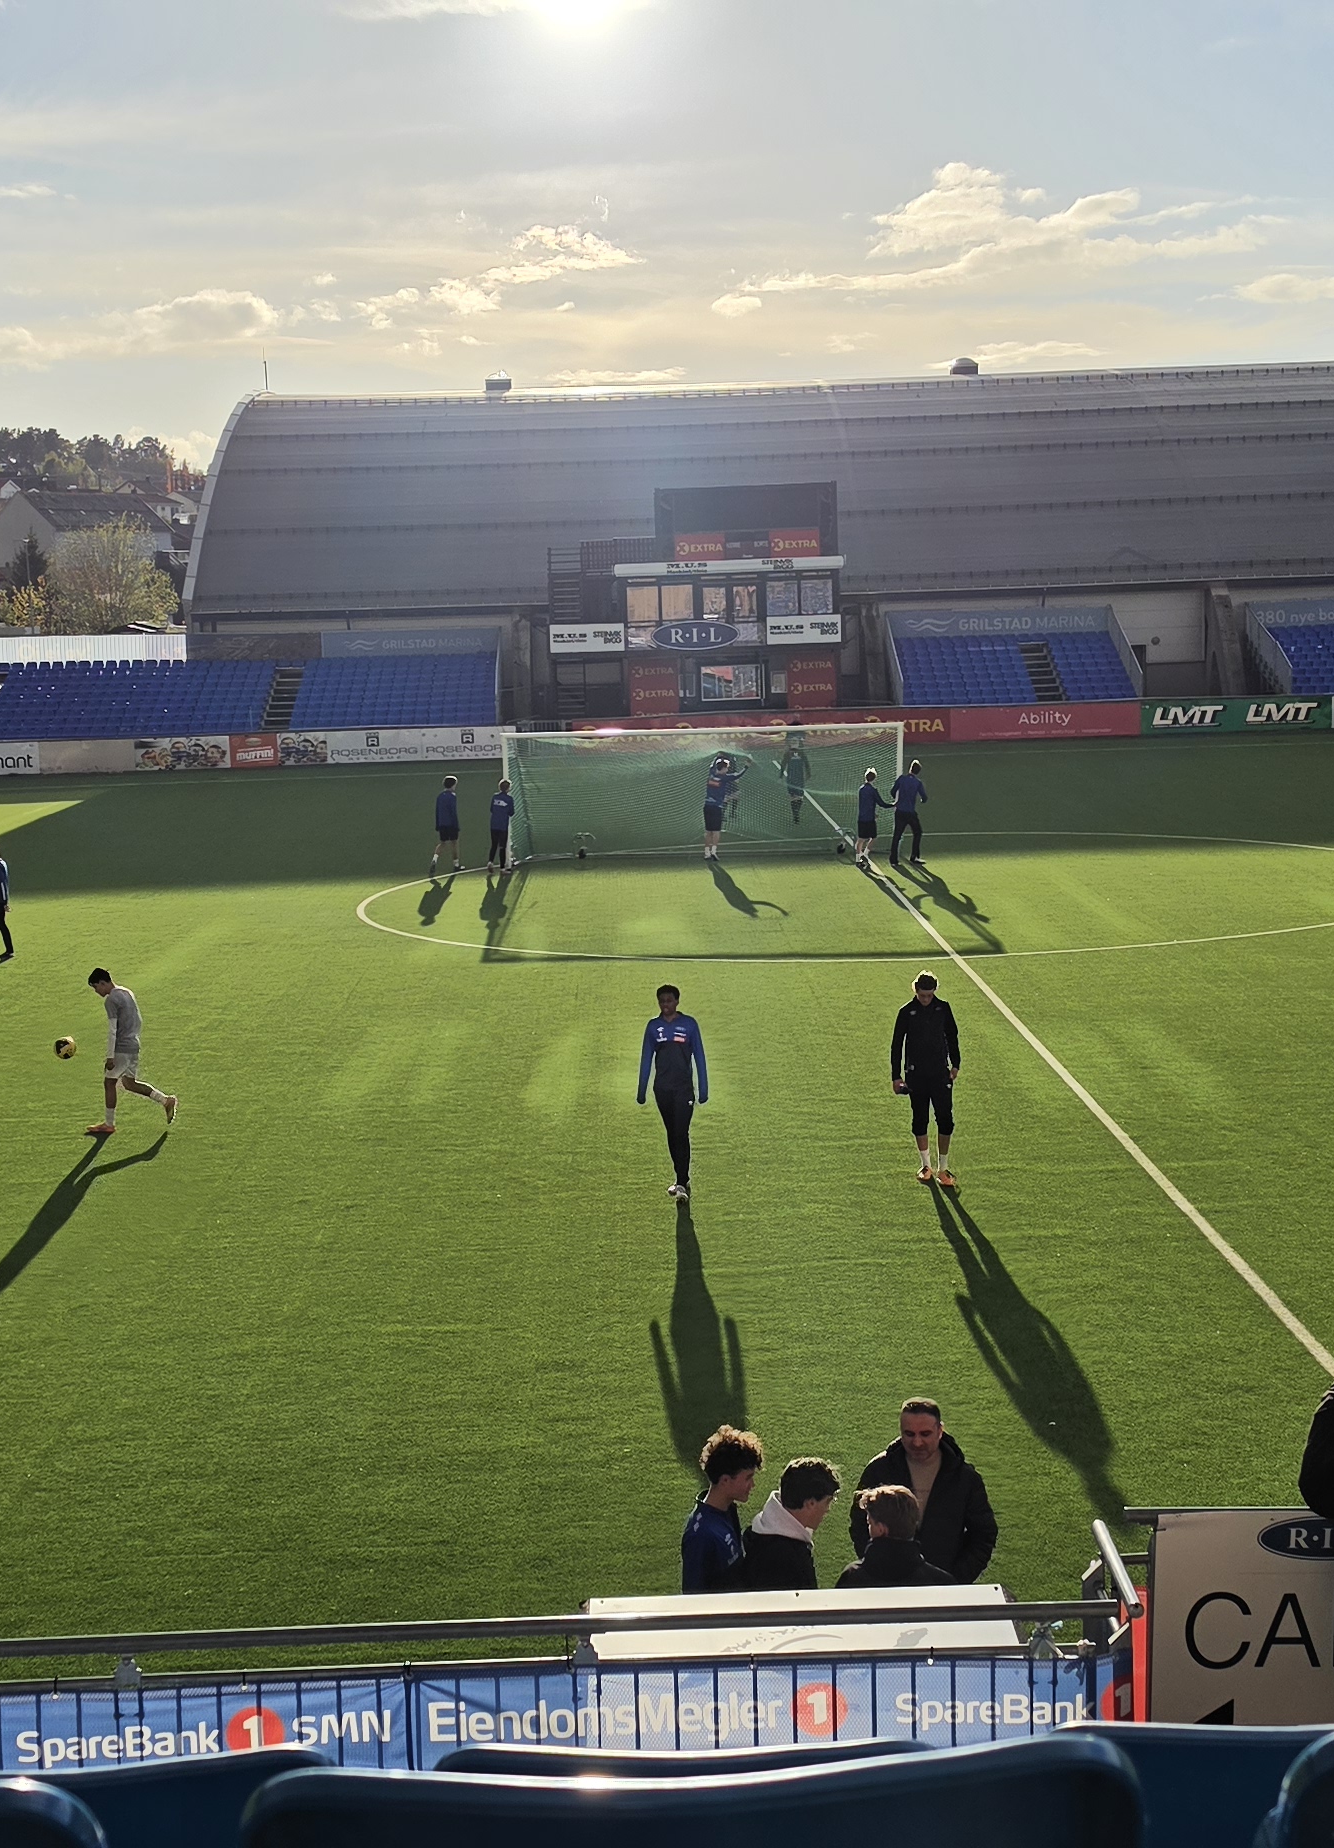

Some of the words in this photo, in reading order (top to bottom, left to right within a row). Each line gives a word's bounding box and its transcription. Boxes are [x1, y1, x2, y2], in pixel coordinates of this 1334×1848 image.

[690, 544, 723, 553] EXTRA
[784, 540, 817, 549] EXTRA
[959, 617, 1031, 632] GRILSTAD
[1036, 616, 1095, 630] MARINA
[1290, 612, 1314, 625] nye
[382, 639, 436, 649] GRILSTAD
[438, 638, 483, 648] MARINA
[1018, 711, 1072, 726] Ability
[331, 747, 418, 758] ROSENBORG
[426, 745, 502, 756] ROSENBOR
[427, 1693, 783, 1744] EiendomsMegler
[806, 1692, 829, 1726] 1
[895, 1692, 1094, 1731] SpareBank
[16, 1721, 221, 1769] SpareBank
[243, 1715, 264, 1750] 1
[292, 1710, 391, 1747] SMN
